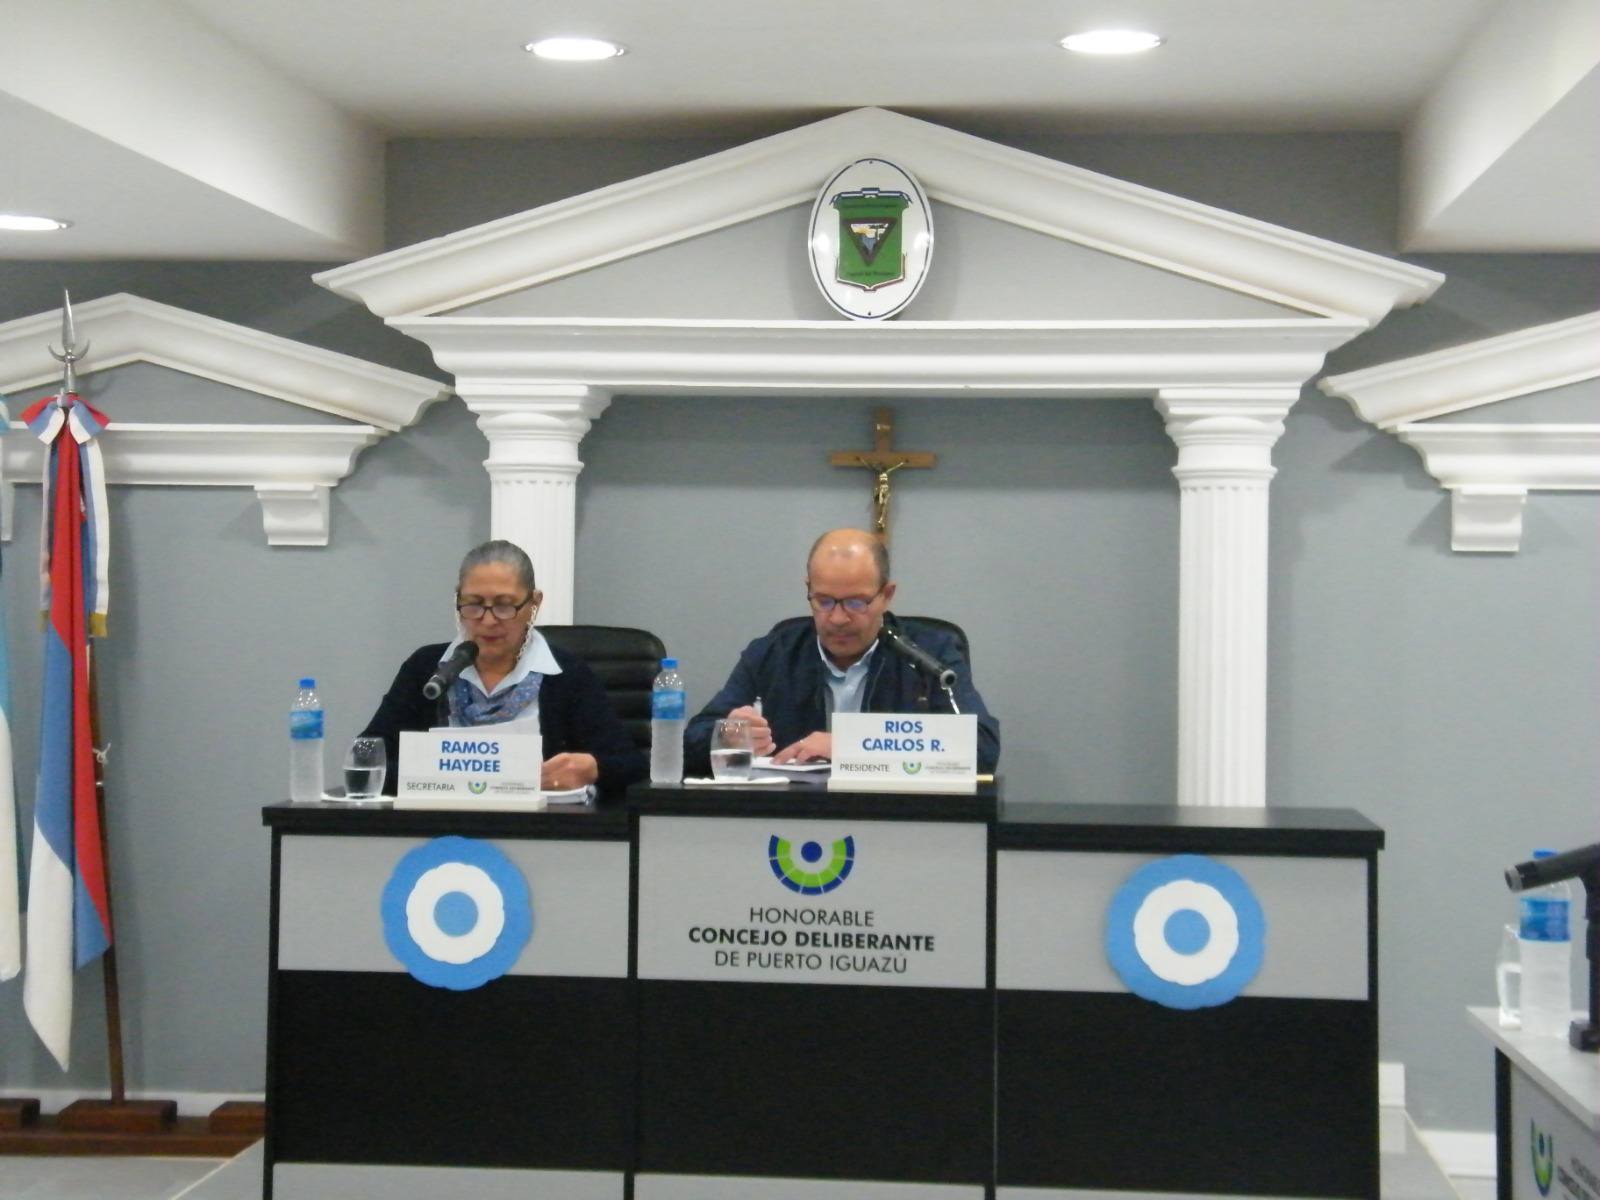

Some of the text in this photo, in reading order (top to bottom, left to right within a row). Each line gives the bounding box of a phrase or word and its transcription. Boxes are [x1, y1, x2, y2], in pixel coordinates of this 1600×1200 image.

[885, 720, 923, 733] RIOS
[441, 740, 499, 754] RAMOS
[862, 738, 945, 752] CARLOS R.
[439, 759, 501, 773] HAYDEE
[839, 763, 890, 772] PRESIDENTE
[406, 782, 456, 791] SECRETARIA
[750, 907, 875, 927] HONORABLE
[688, 927, 936, 951] CONCEJO DELIBERANTE
[715, 950, 740, 967] DE
[747, 951, 822, 970] PUERTO
